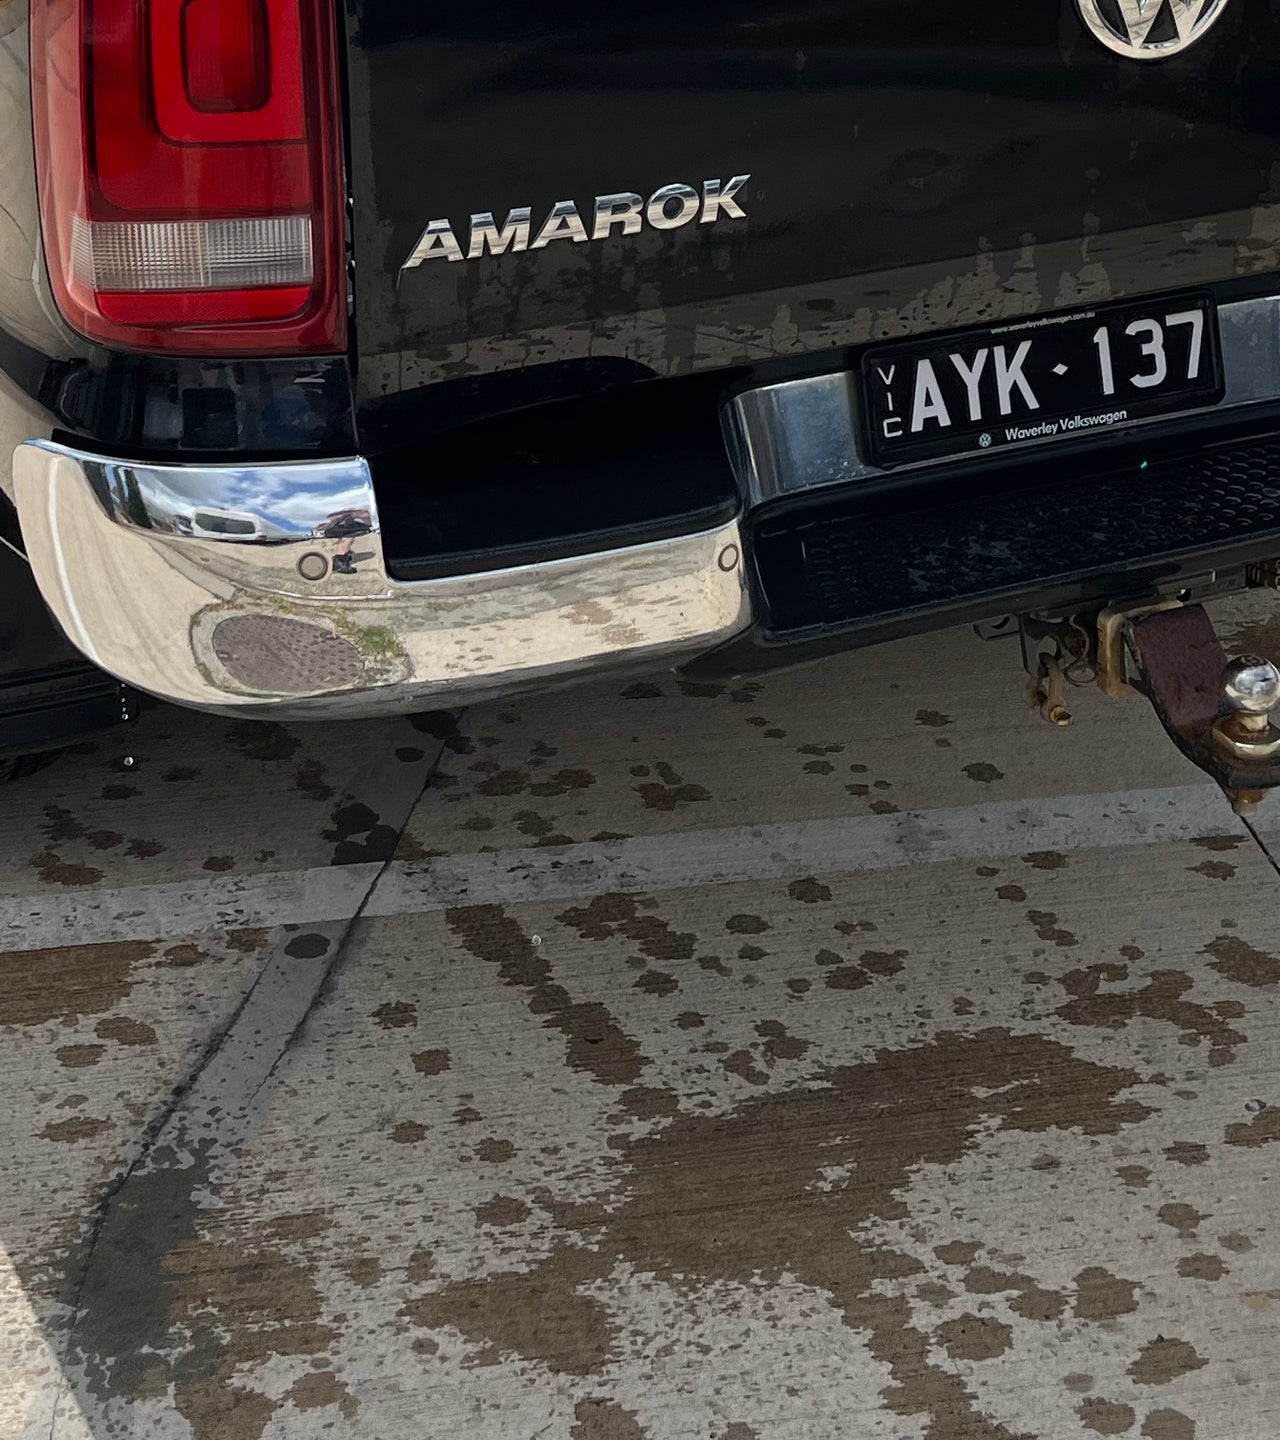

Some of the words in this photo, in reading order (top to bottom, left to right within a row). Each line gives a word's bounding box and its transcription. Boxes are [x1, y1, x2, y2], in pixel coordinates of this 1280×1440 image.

[402, 174, 751, 268] AMAROK
[876, 364, 904, 438] VIC
[1005, 421, 1059, 441] Waverley
[1059, 409, 1128, 431] Volkswagen
